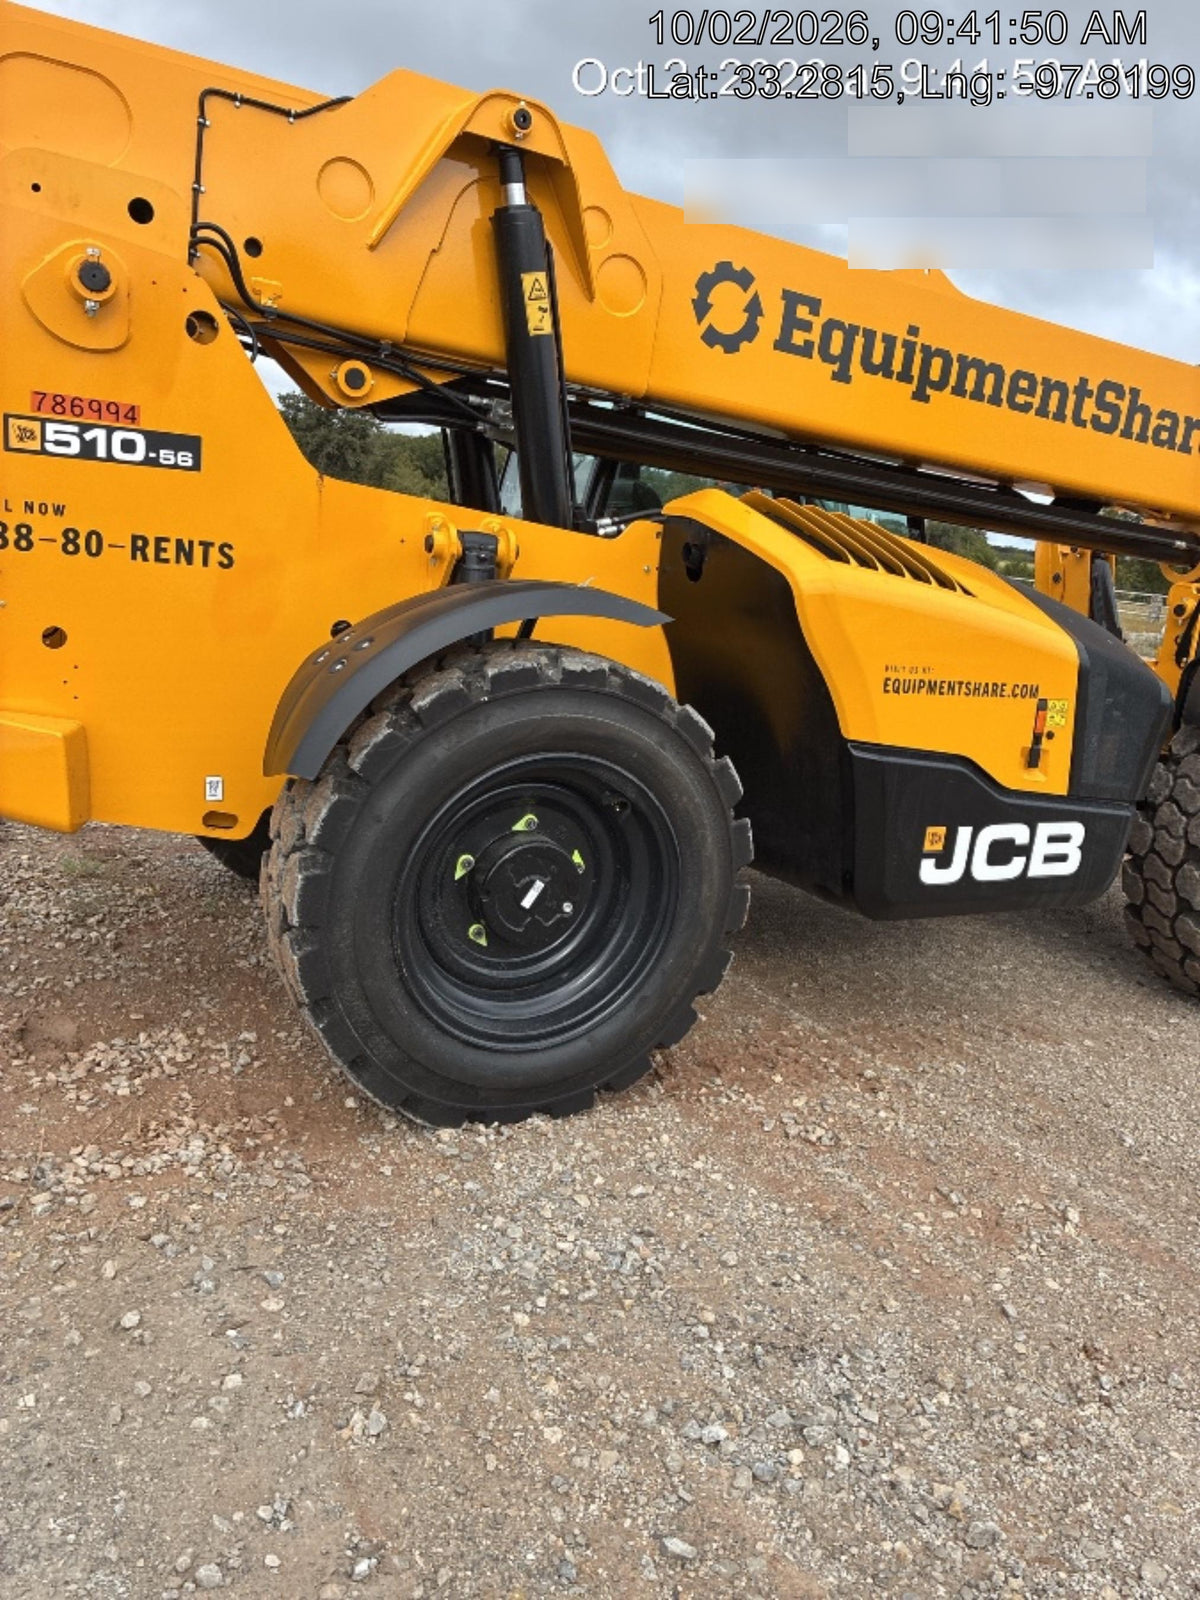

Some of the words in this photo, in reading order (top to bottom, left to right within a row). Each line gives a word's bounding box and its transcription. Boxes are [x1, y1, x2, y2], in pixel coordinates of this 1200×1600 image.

[773, 288, 1200, 456] EquipmentShar
[32, 391, 138, 424] 786994
[24, 500, 66, 517] NOW
[883, 676, 1040, 699] EQUIPMENTSHARE.COM
[919, 821, 1086, 885] JCB
